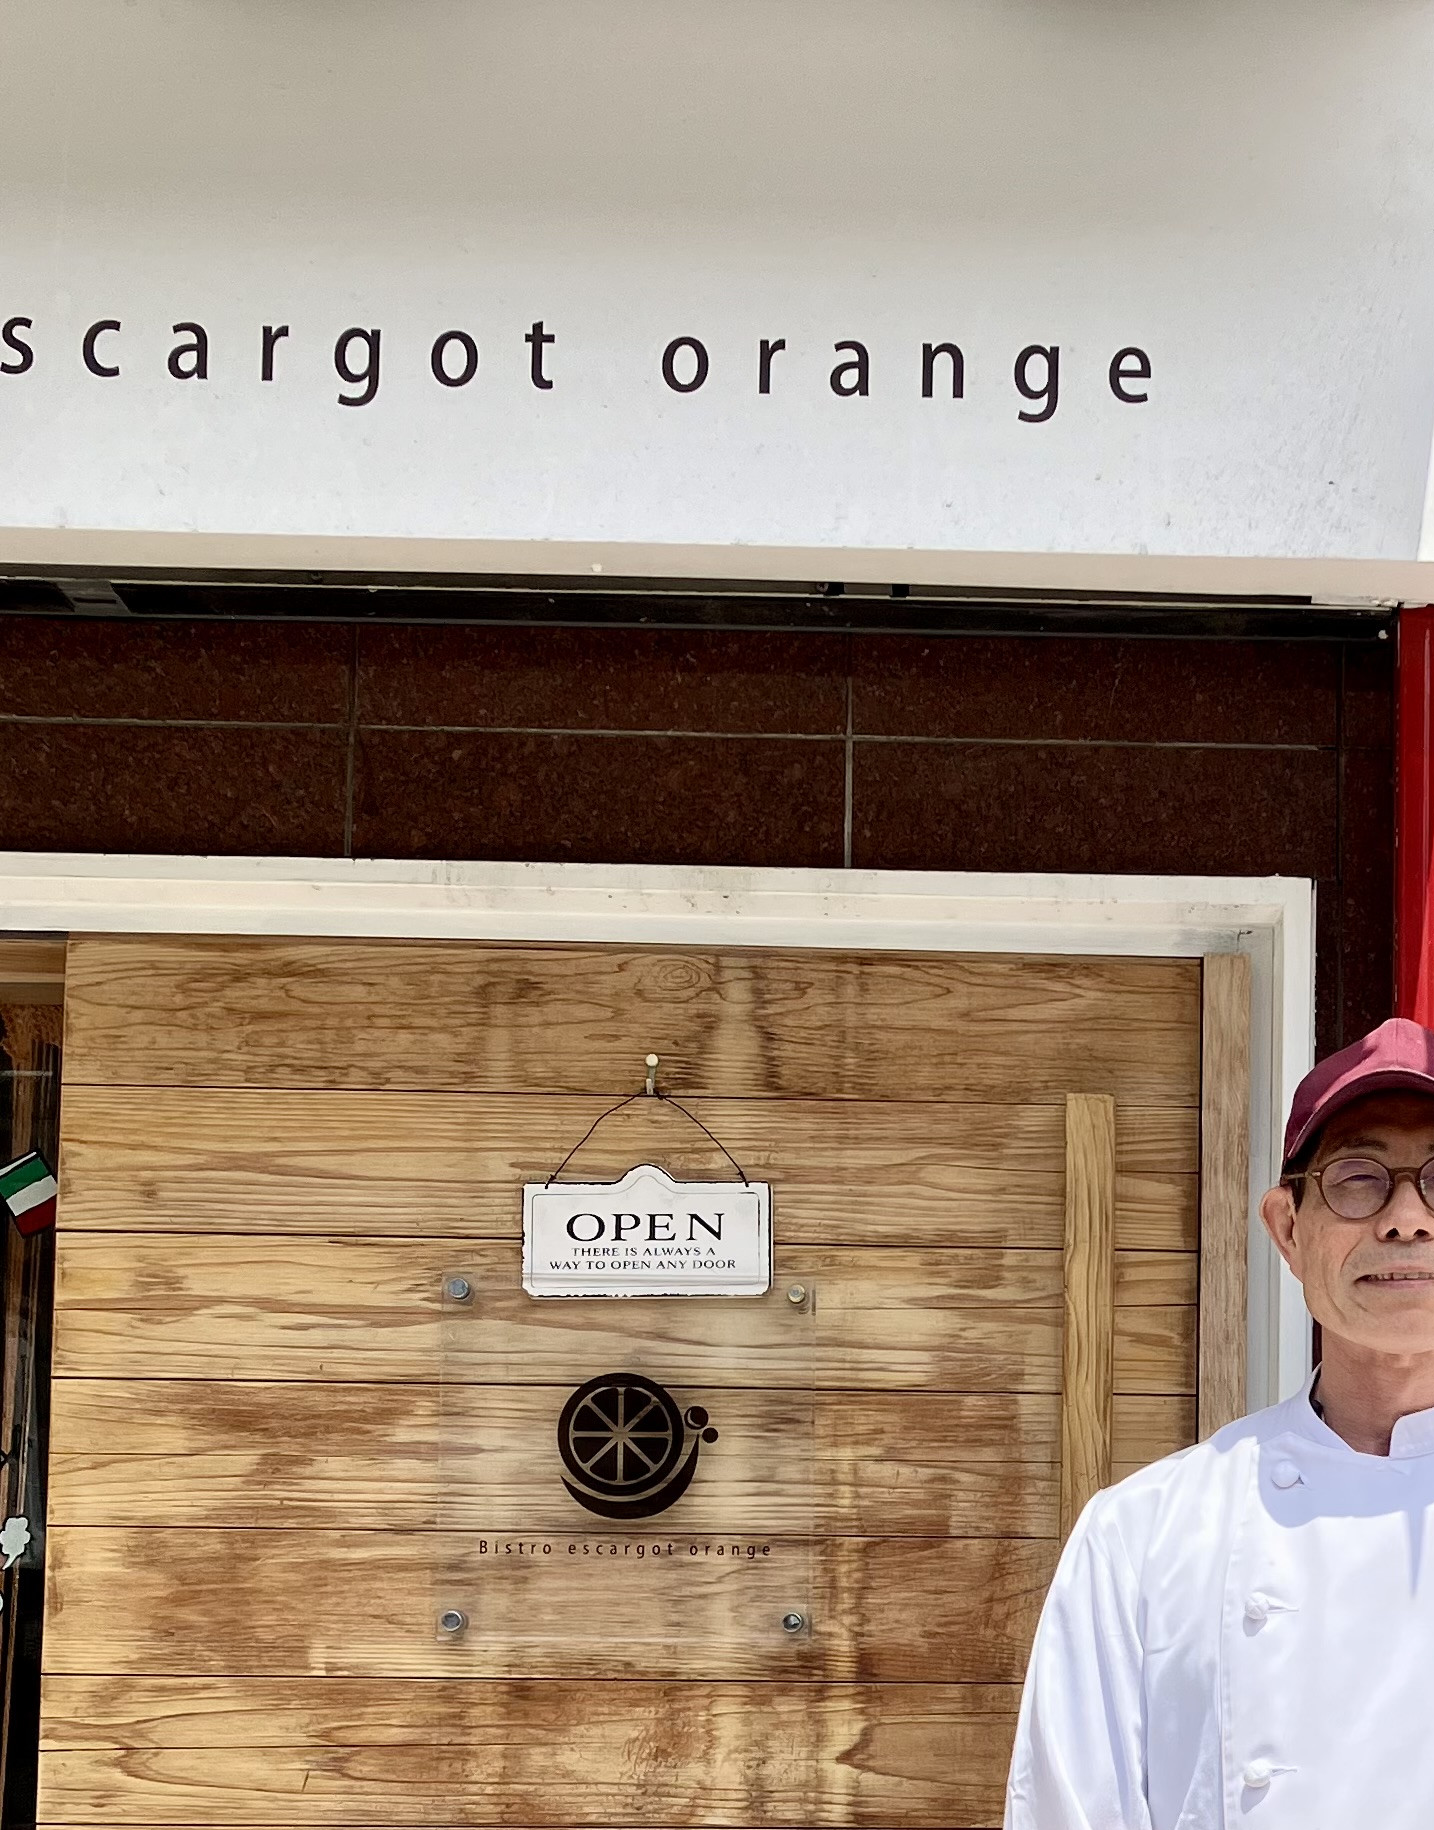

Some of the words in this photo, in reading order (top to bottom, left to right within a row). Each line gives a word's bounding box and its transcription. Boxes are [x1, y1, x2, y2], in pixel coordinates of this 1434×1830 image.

[0, 316, 557, 407] scargot
[660, 332, 1154, 424] orange
[566, 1212, 725, 1242] OPEN
[573, 1247, 620, 1257] THERE
[624, 1247, 638, 1257] IS
[642, 1246, 702, 1257] ALWAYS
[705, 1247, 716, 1257] A
[549, 1260, 581, 1270] WAY
[586, 1260, 606, 1270] TO
[610, 1260, 652, 1270] OPEN
[656, 1259, 688, 1270] ANY
[692, 1258, 737, 1270] DOOR
[478, 1539, 552, 1555] Bistro
[567, 1541, 674, 1559] escargot
[689, 1544, 772, 1560] orange
